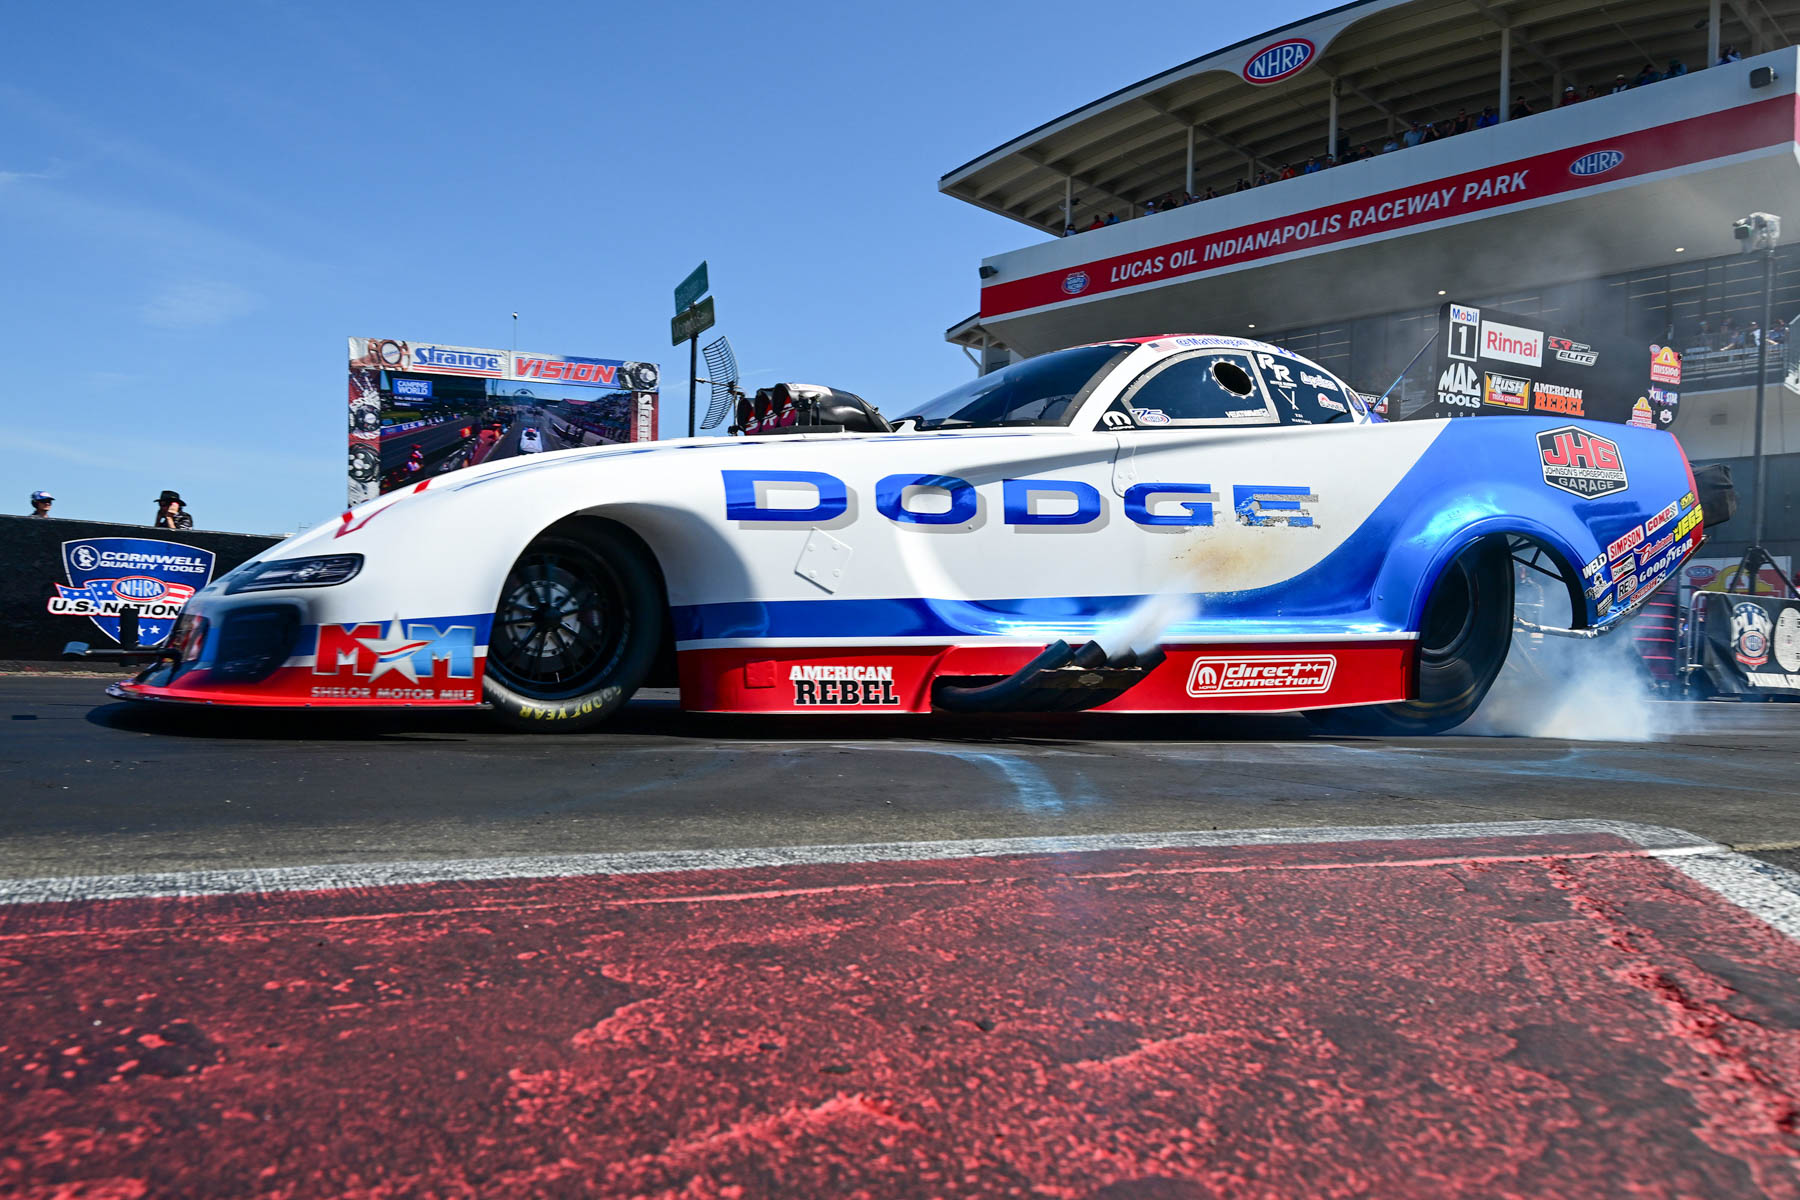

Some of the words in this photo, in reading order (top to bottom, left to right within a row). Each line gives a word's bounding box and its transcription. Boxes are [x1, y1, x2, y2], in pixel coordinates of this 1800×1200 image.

[1254, 45, 1304, 76] NHRA
[1574, 151, 1620, 175] NHRA
[1110, 256, 1164, 283] LUCAS
[1169, 249, 1198, 269] OIL
[1203, 213, 1342, 262] INDIANAPOLIS
[1348, 187, 1457, 229] RACEWAY
[1462, 170, 1530, 203] PARK
[1452, 308, 1478, 324] Mobil
[1459, 325, 1468, 355] 1
[1487, 331, 1537, 358] Rinnai
[412, 346, 498, 370] Strange
[1559, 351, 1594, 363] ELITE
[515, 357, 617, 384] VISION
[1438, 363, 1481, 397] MAC
[1489, 375, 1526, 396] RUSH
[1533, 382, 1583, 399] AMERICAN
[1438, 391, 1481, 408] TOOLS
[1534, 392, 1584, 416] REBEL
[1542, 432, 1621, 470] JHG
[1545, 466, 1578, 477] JOHNSON'S
[1579, 469, 1625, 480] HORSEPOWERED
[1558, 477, 1615, 493] GARAGE
[721, 470, 1320, 533] DODGE
[1647, 508, 1671, 532] COMP
[1675, 503, 1704, 542] JEGS
[1610, 527, 1642, 559] SIMPSON
[100, 560, 158, 571] QUALITY
[162, 563, 206, 574] TOOLS
[102, 551, 206, 567] CORNWELL
[1582, 553, 1608, 579] WELD
[1639, 538, 1693, 583] GOODYEAR
[119, 579, 162, 597] NHRA
[52, 600, 95, 613] U.S.
[103, 602, 182, 616] NATION
[789, 665, 893, 681] AMERICAN
[311, 686, 372, 698] SHELOR
[376, 687, 434, 700] MOTOR
[439, 689, 475, 701] MILE
[794, 680, 900, 706] REBEL
